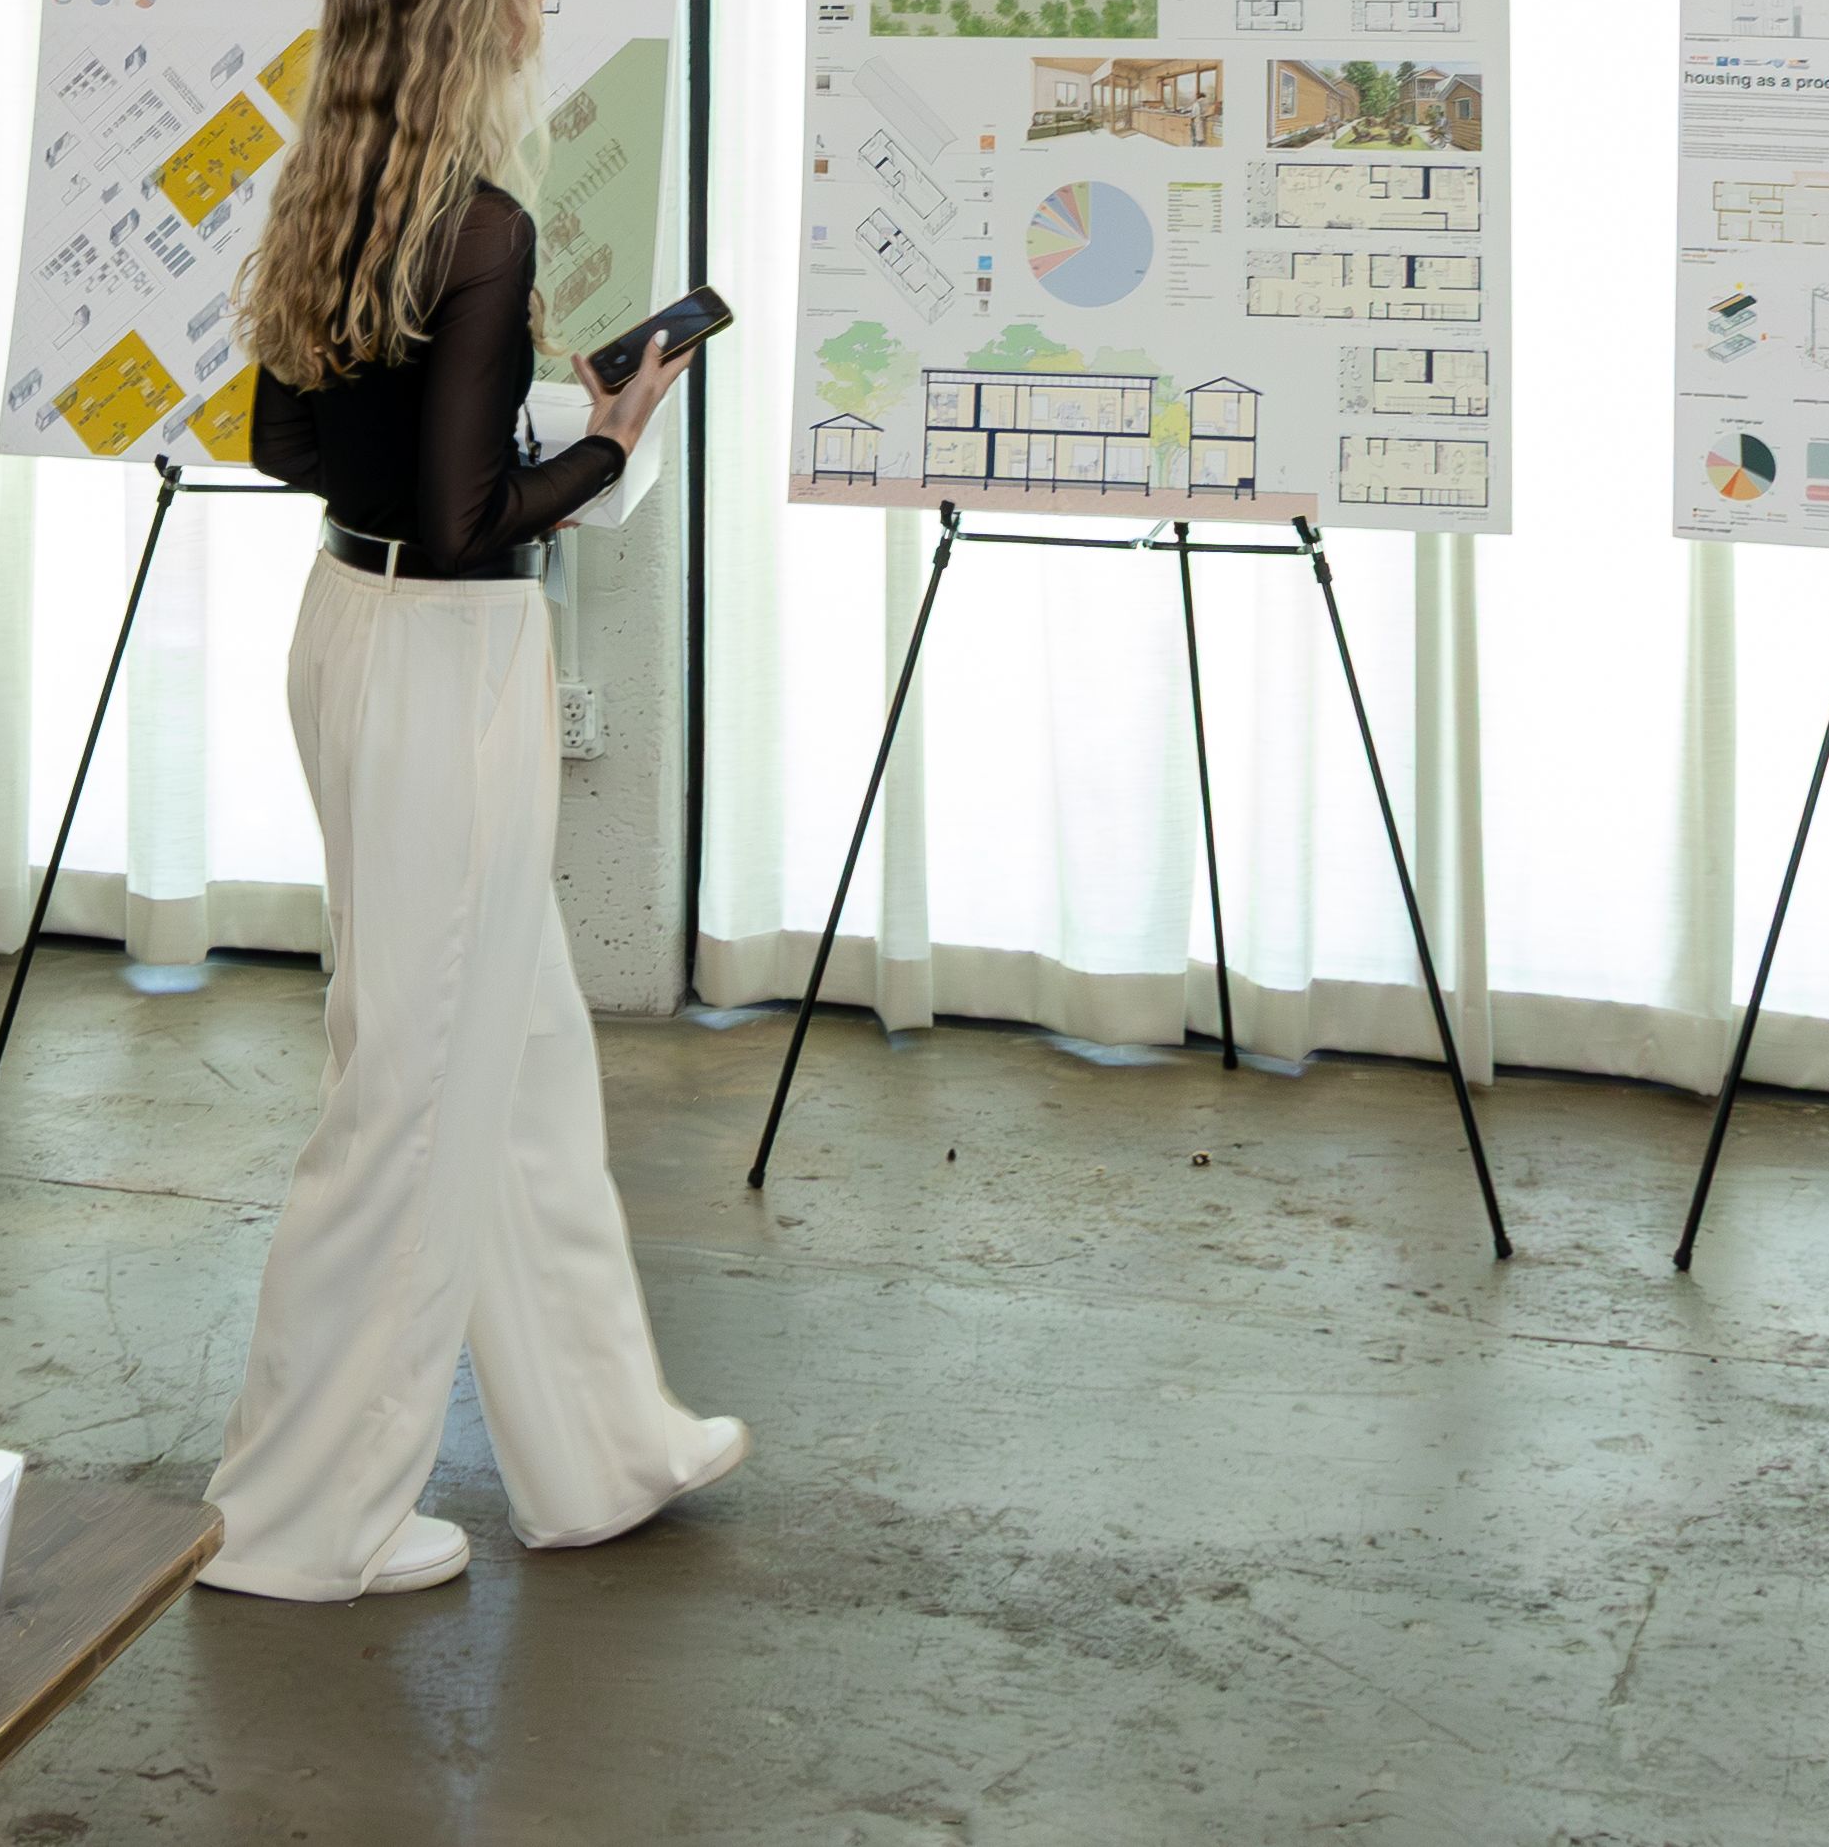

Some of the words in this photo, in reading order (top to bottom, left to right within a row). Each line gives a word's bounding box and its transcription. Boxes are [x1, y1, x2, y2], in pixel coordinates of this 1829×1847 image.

[1684, 71, 1752, 89] housing
[1756, 76, 1776, 87] as
[1780, 76, 1791, 88] a
